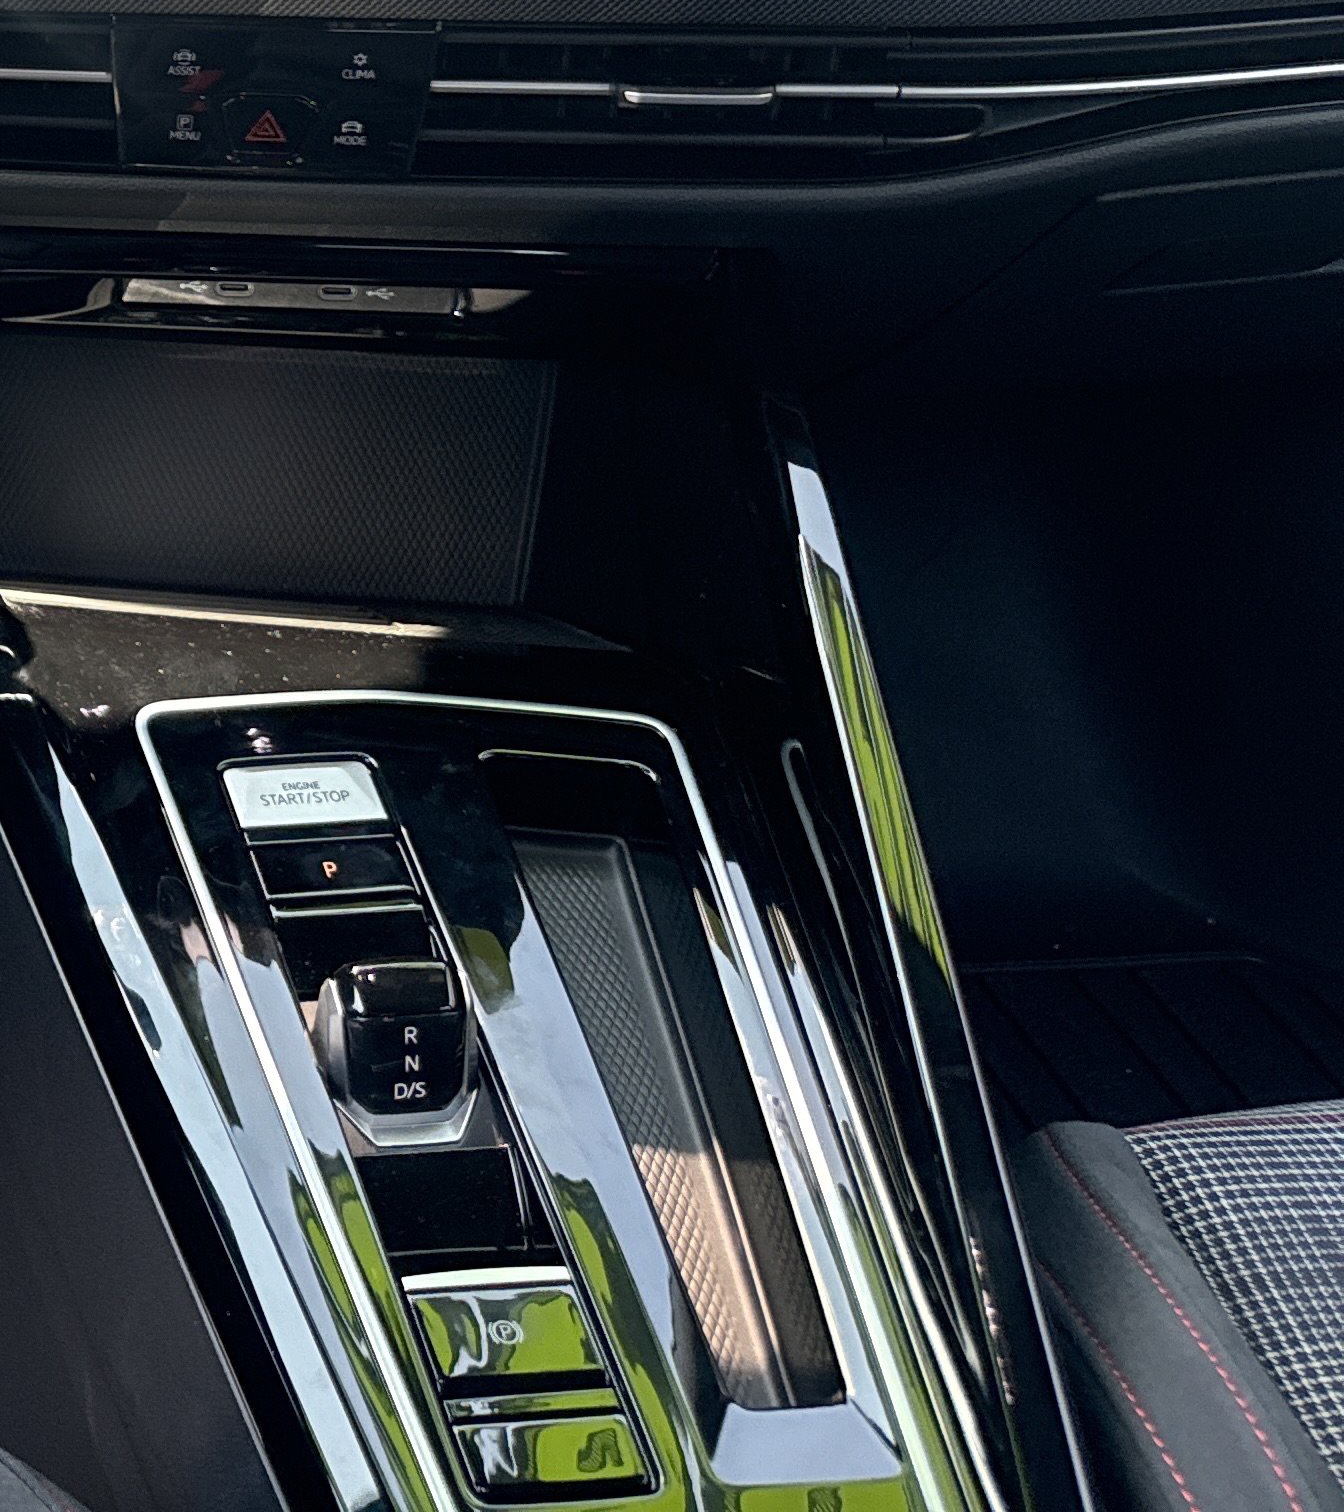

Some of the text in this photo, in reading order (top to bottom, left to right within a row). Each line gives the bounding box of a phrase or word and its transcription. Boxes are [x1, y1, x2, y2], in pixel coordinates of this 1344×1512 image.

[167, 65, 201, 76] ASSIST
[341, 69, 376, 80] CLIMA
[169, 130, 202, 141] MENU
[333, 135, 368, 147] MODE
[281, 780, 321, 791] ENGINE
[259, 790, 350, 807] START/STOP
[322, 861, 338, 879] P
[404, 1027, 418, 1045] R
[405, 1055, 420, 1071] N
[393, 1082, 427, 1100] D/S
